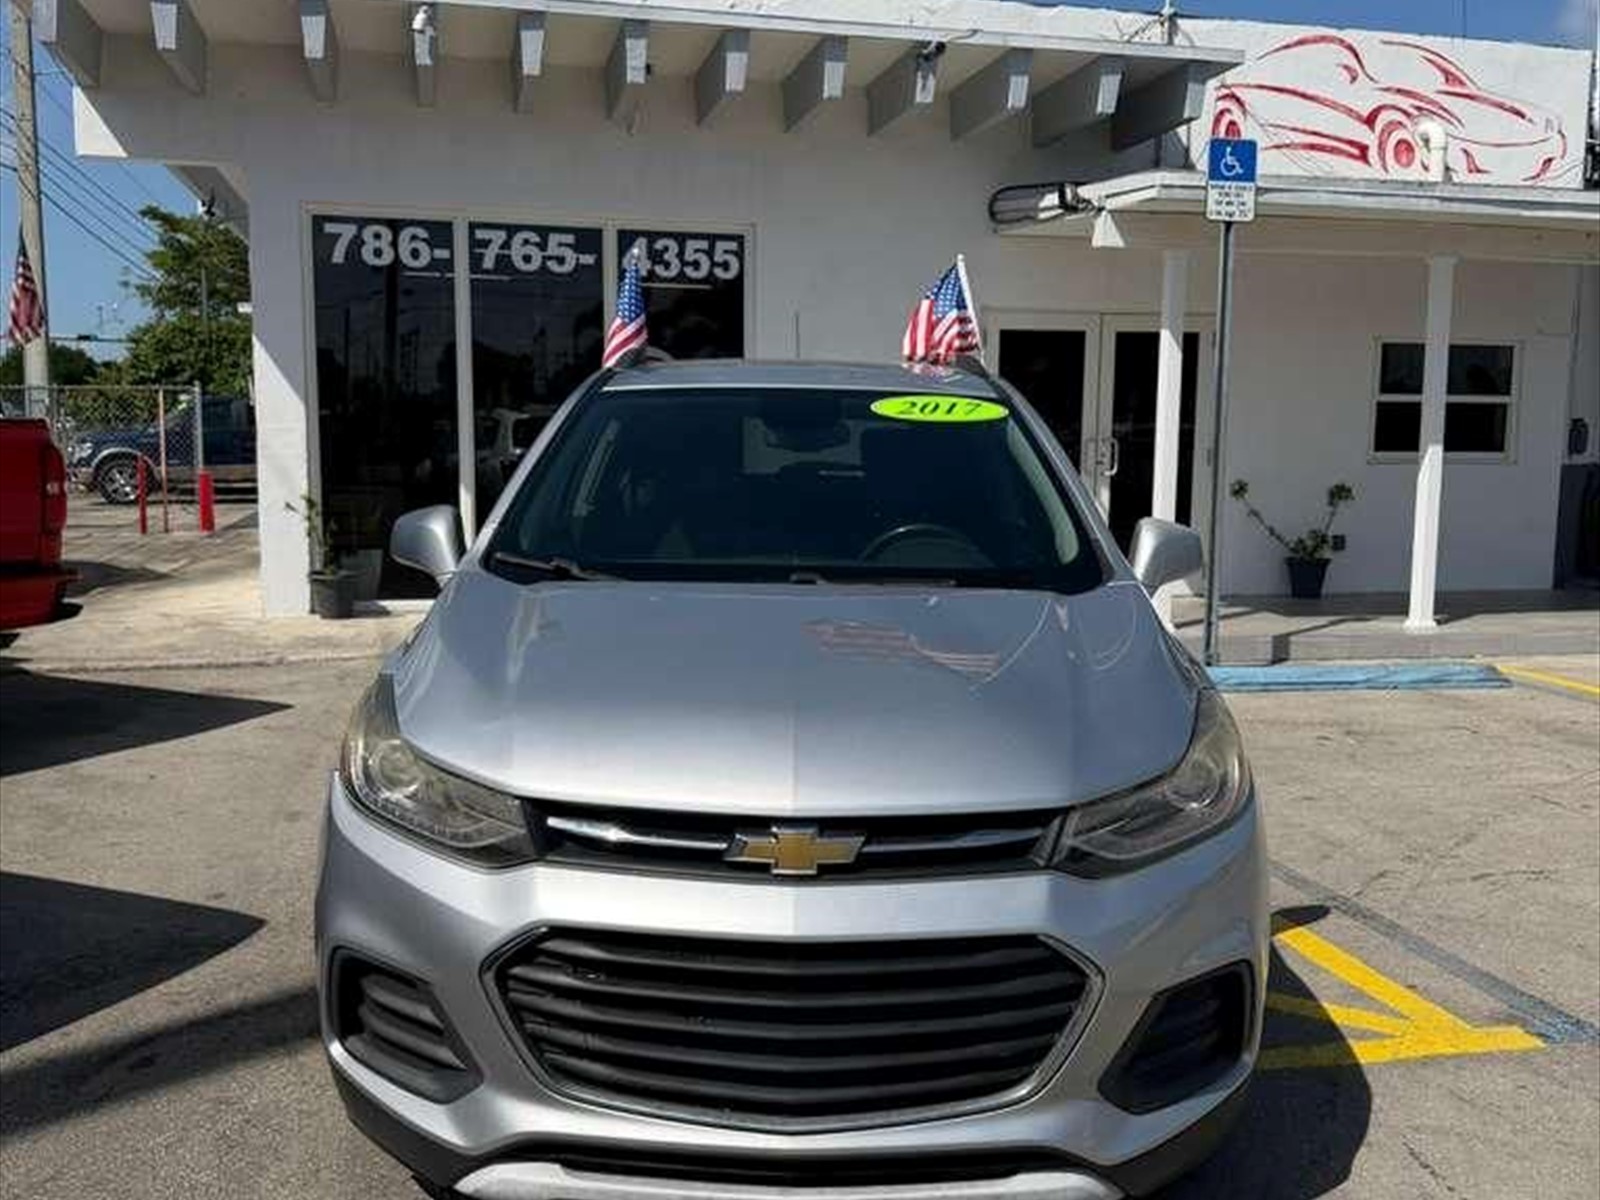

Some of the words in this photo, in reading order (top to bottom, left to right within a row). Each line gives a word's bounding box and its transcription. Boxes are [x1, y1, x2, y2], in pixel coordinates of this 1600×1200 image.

[323, 222, 450, 268] 786-
[475, 229, 597, 274] 765-
[622, 237, 740, 280] 4355
[898, 401, 982, 416] 2017
